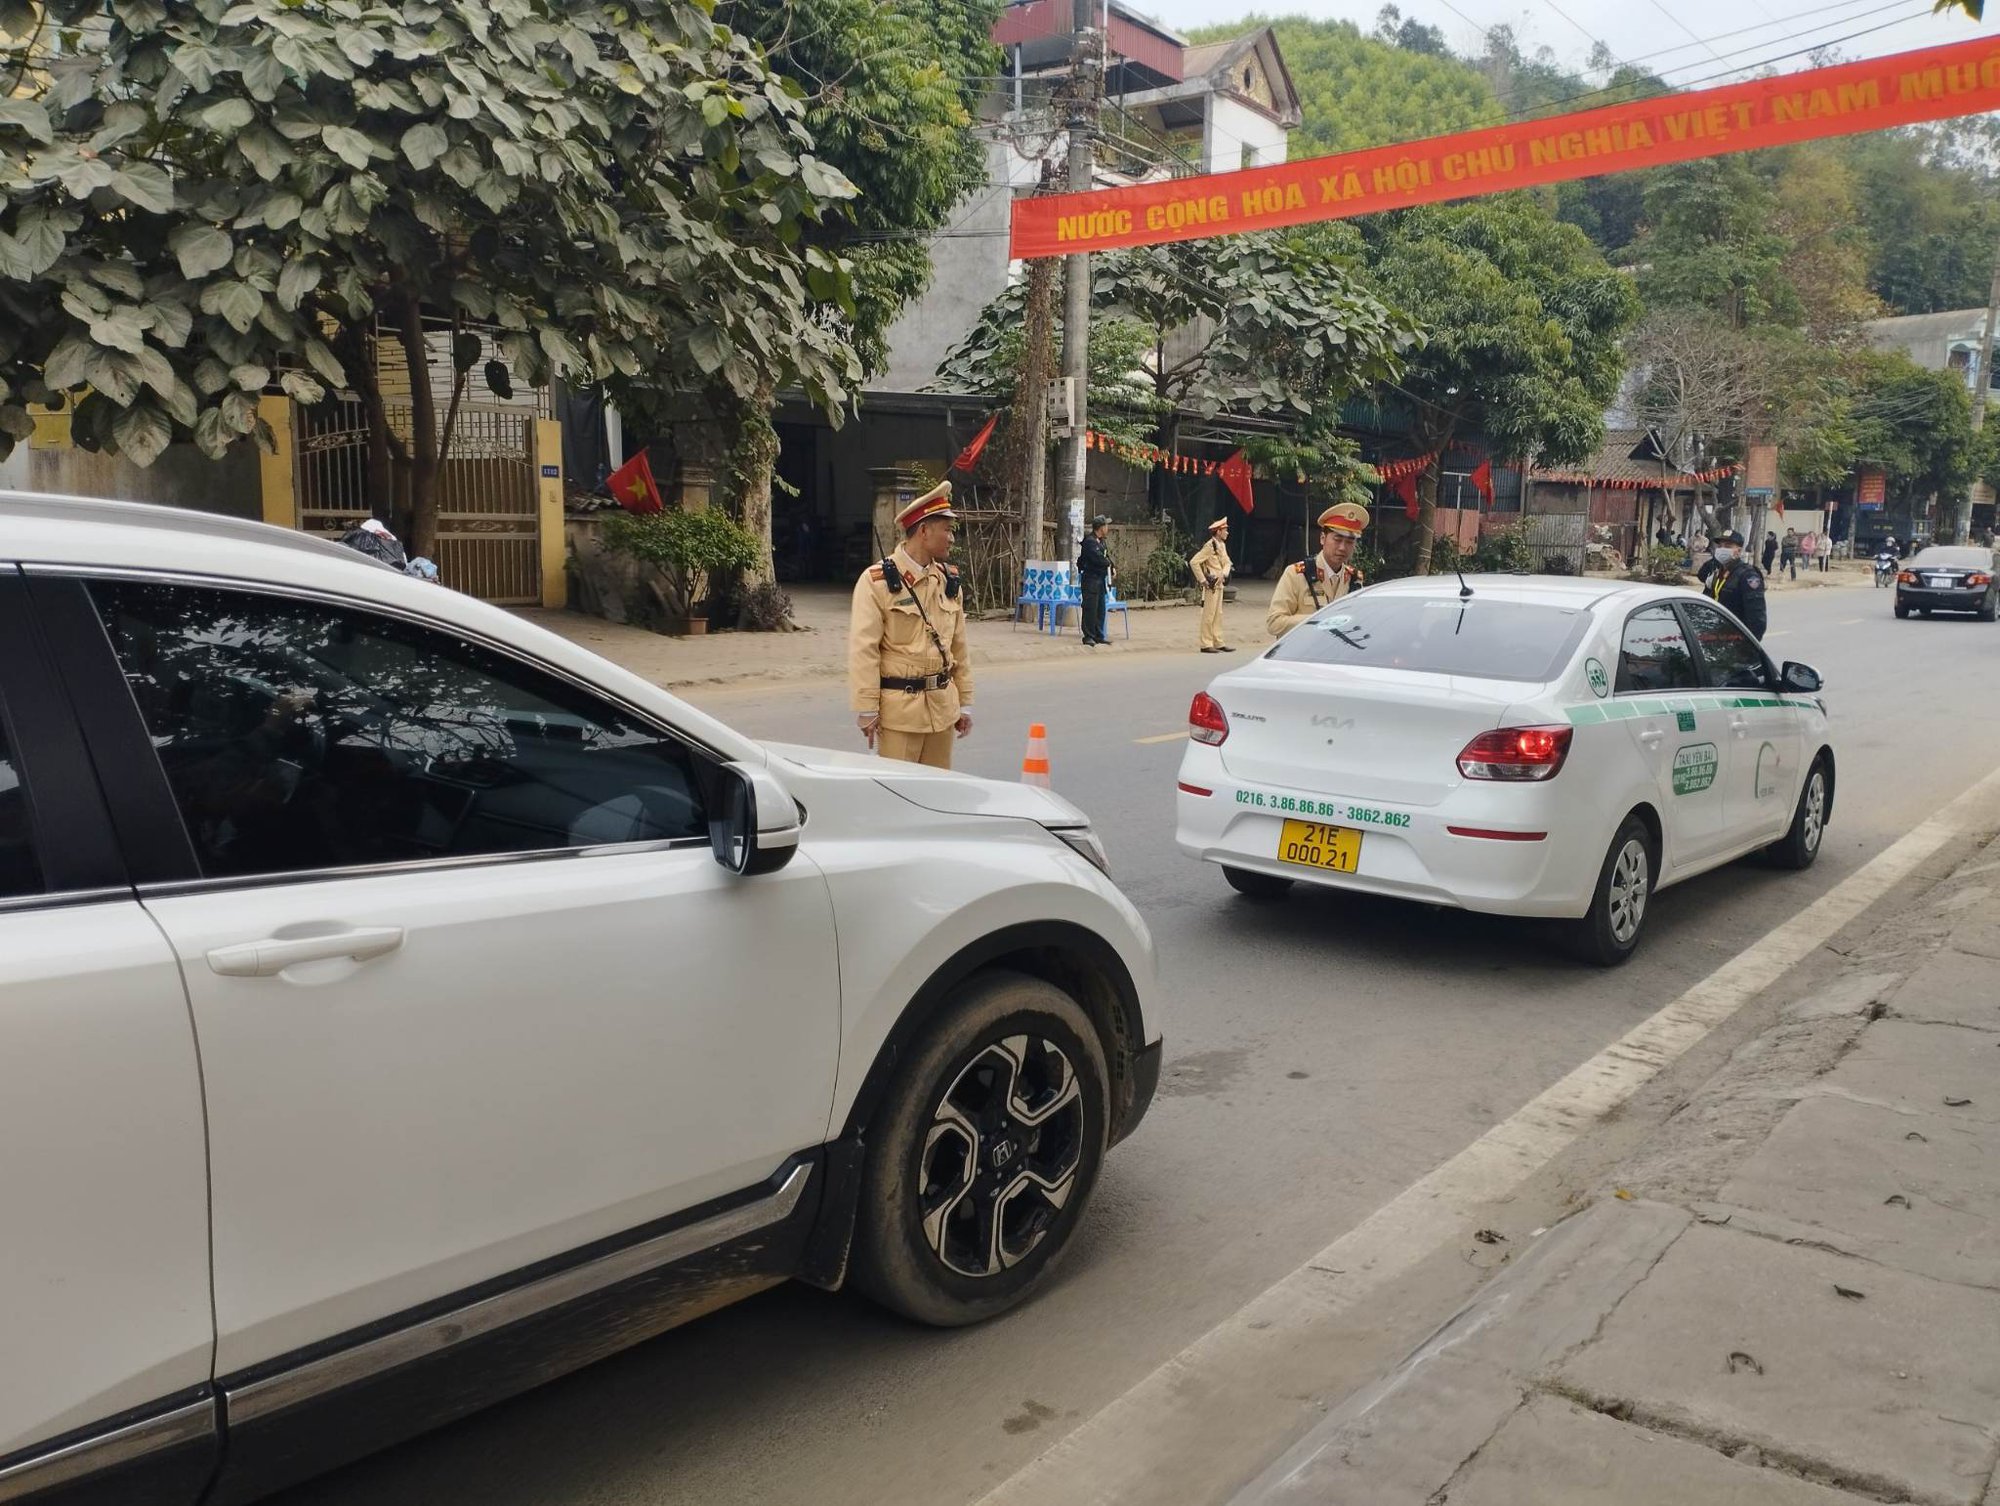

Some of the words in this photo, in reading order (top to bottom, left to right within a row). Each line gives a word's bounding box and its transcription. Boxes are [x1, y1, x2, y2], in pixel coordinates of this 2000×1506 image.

[1058, 203, 1133, 241] NƯỚC
[1146, 195, 1229, 233] CỘNG
[1242, 179, 1306, 217] HÒA
[1318, 165, 1364, 204] XÃ
[1373, 156, 1432, 195] HỘI
[1442, 134, 1515, 181] CHỦ
[1529, 117, 1655, 167] NGHĨA
[1664, 100, 1755, 141] VIỆT
[1771, 79, 1880, 124] NAM
[1236, 790, 1266, 807] 0216.
[1270, 795, 1334, 817] 3.86.86.86
[1347, 806, 1411, 828] 3862.862
[1304, 825, 1340, 846] 21E
[1287, 842, 1347, 869] 000.21
